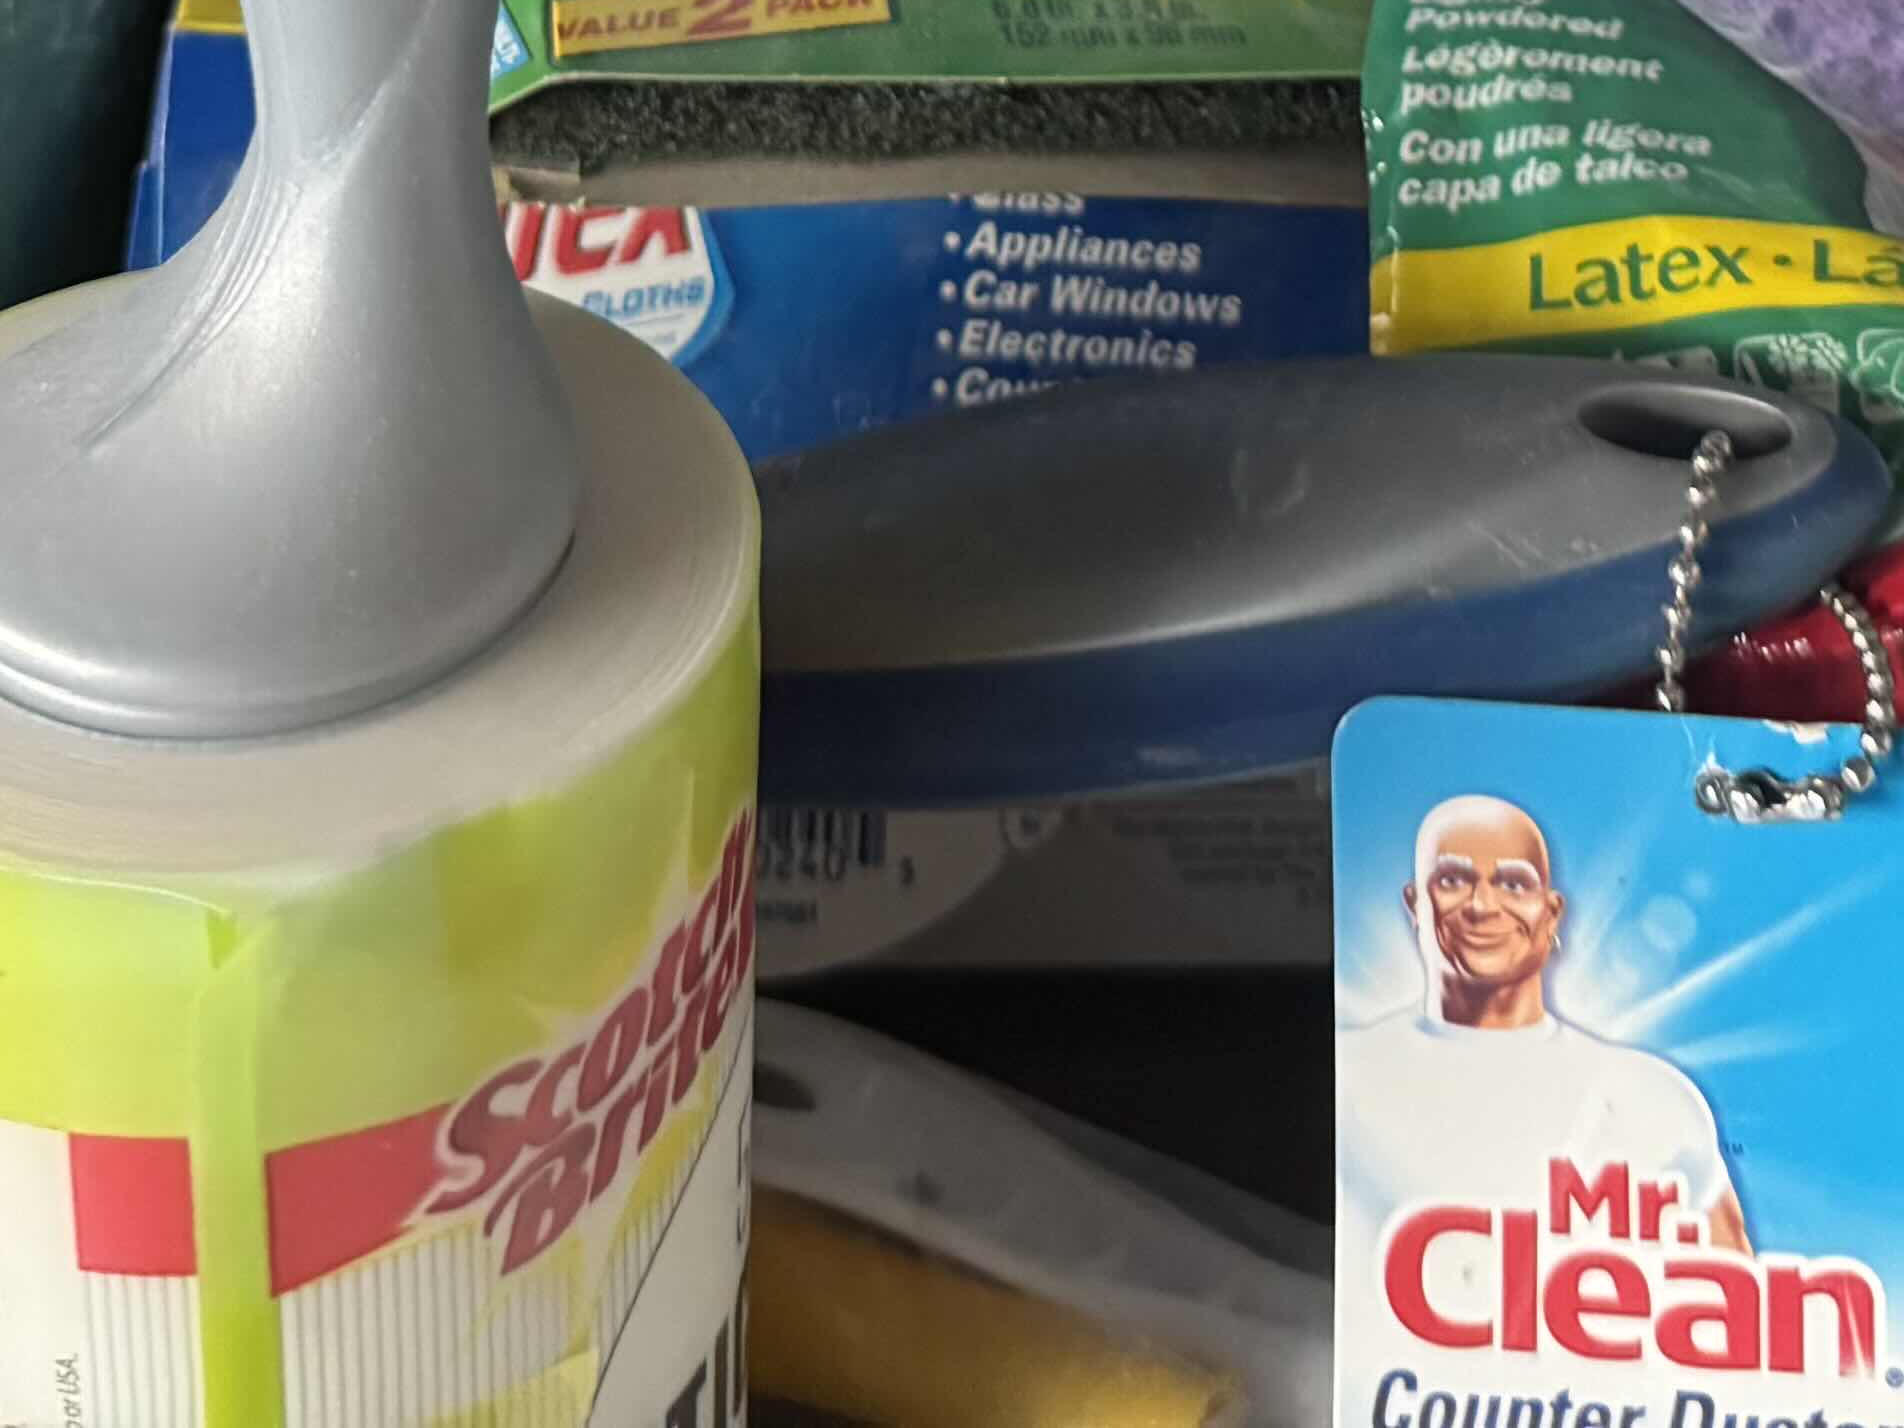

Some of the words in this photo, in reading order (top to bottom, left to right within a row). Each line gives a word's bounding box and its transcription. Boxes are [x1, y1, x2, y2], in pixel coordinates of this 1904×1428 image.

[558, 5, 681, 44] VALUE
[1404, 5, 1626, 41] Powdered
[1398, 128, 1485, 166] Con
[1492, 124, 1572, 159] una
[1581, 117, 1713, 157] ligera
[1397, 173, 1503, 214] capa
[1510, 156, 1564, 196] de
[1574, 151, 1690, 185] talco
[963, 220, 1202, 275] Appliances
[963, 270, 1040, 311] Car
[1049, 273, 1243, 326] Windows
[1528, 238, 1753, 314] Latex
[957, 318, 1198, 372] Electronics
[1547, 1156, 1700, 1244] Mr.
[1382, 1202, 1878, 1382] Clean
[55, 1354, 79, 1394] USA.
